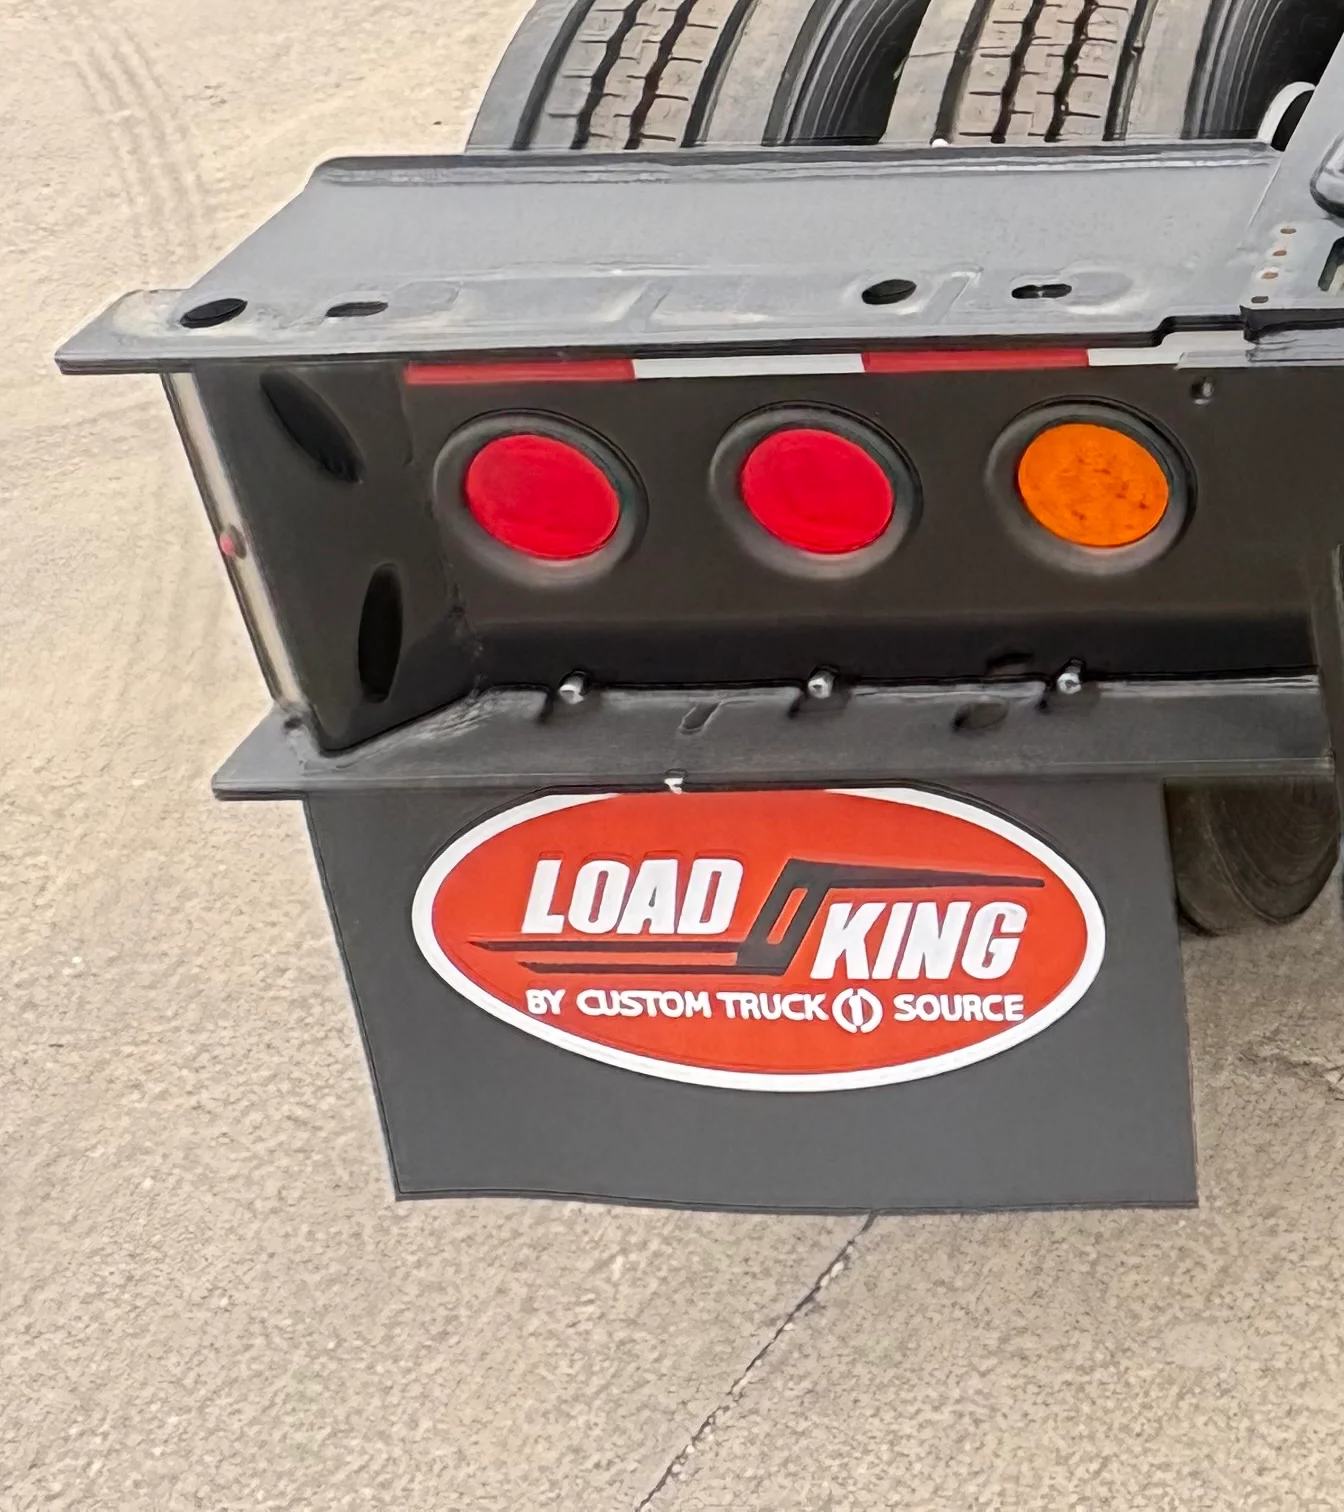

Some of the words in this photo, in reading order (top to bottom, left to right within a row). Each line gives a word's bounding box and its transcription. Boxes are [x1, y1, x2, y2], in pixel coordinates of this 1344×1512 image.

[521, 859, 744, 936] LOAD
[810, 901, 1028, 980] KING
[526, 989, 562, 1016] BY
[576, 989, 711, 1019] CUSTOM
[721, 991, 829, 1022] TRUCK
[893, 994, 1025, 1023] SOURCE
